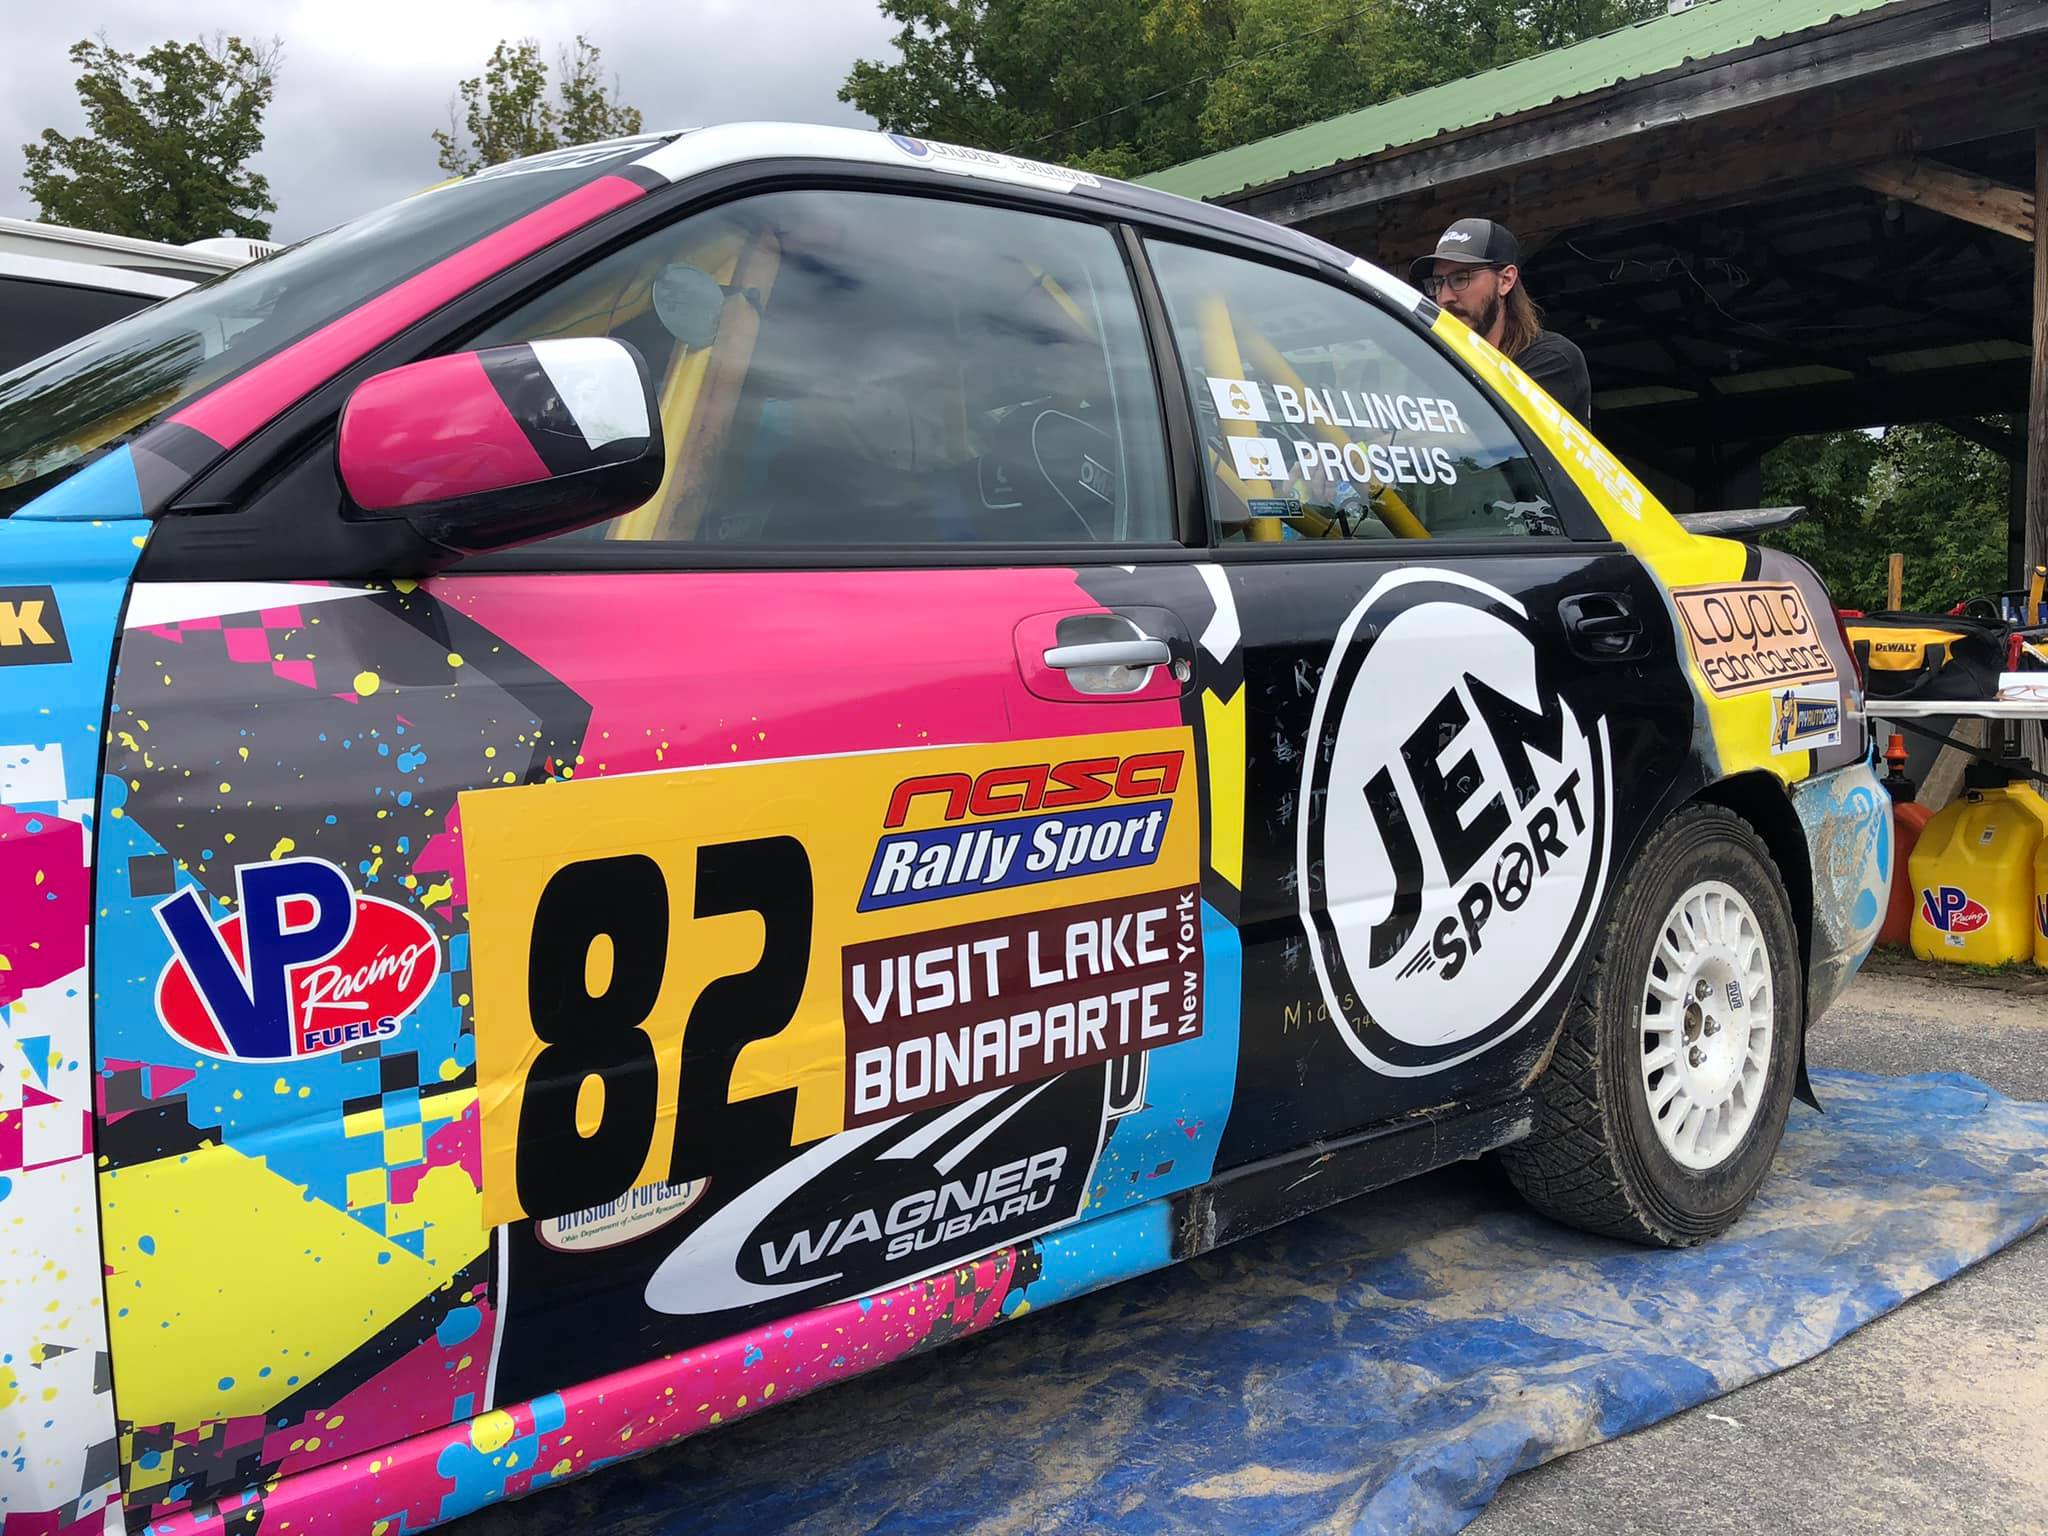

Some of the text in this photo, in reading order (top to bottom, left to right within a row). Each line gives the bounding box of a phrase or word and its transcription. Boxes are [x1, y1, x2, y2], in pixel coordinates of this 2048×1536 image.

[1010, 157, 1097, 185] Solutions
[1272, 384, 1467, 434] BALLINGER
[1293, 440, 1458, 485] PROSEUS
[871, 810, 1163, 897] Rally Sport
[1362, 671, 1565, 969] JEM
[1432, 768, 1587, 981] SPORT
[1922, 886, 1967, 931] VP
[156, 859, 353, 1058] VP
[1952, 912, 1987, 926] Racing
[300, 943, 434, 1029] Racing
[852, 907, 1170, 1024] VISIT LAKE
[1176, 891, 1198, 1035] New York
[304, 1016, 397, 1050] FUELS
[515, 834, 814, 1220] 82
[854, 981, 1170, 1116] BONAPARTE
[1283, 993, 1354, 1034] Mids
[760, 1145, 1068, 1277] WAGNER
[885, 1184, 1056, 1261] SUBARU
